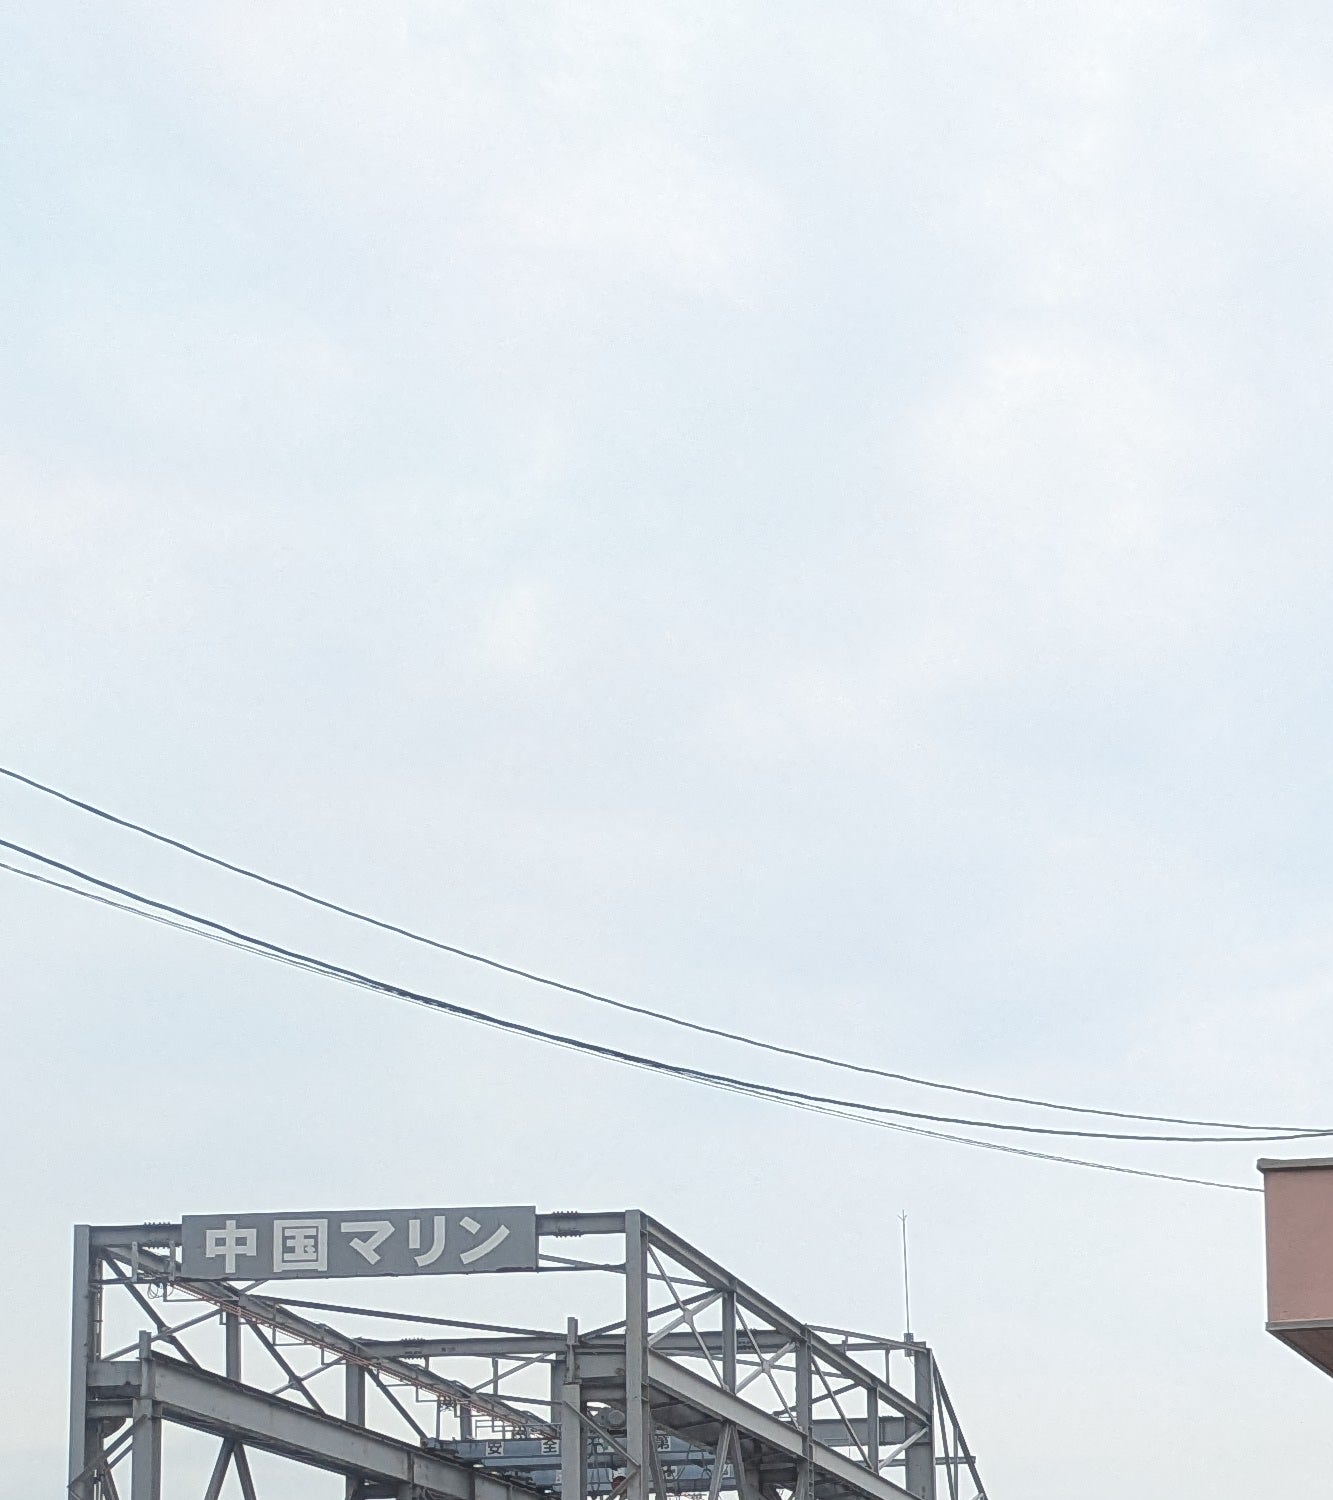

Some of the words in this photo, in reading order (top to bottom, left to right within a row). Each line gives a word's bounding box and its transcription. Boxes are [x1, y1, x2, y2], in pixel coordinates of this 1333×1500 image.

[205, 1215, 511, 1274] 中国マリン
